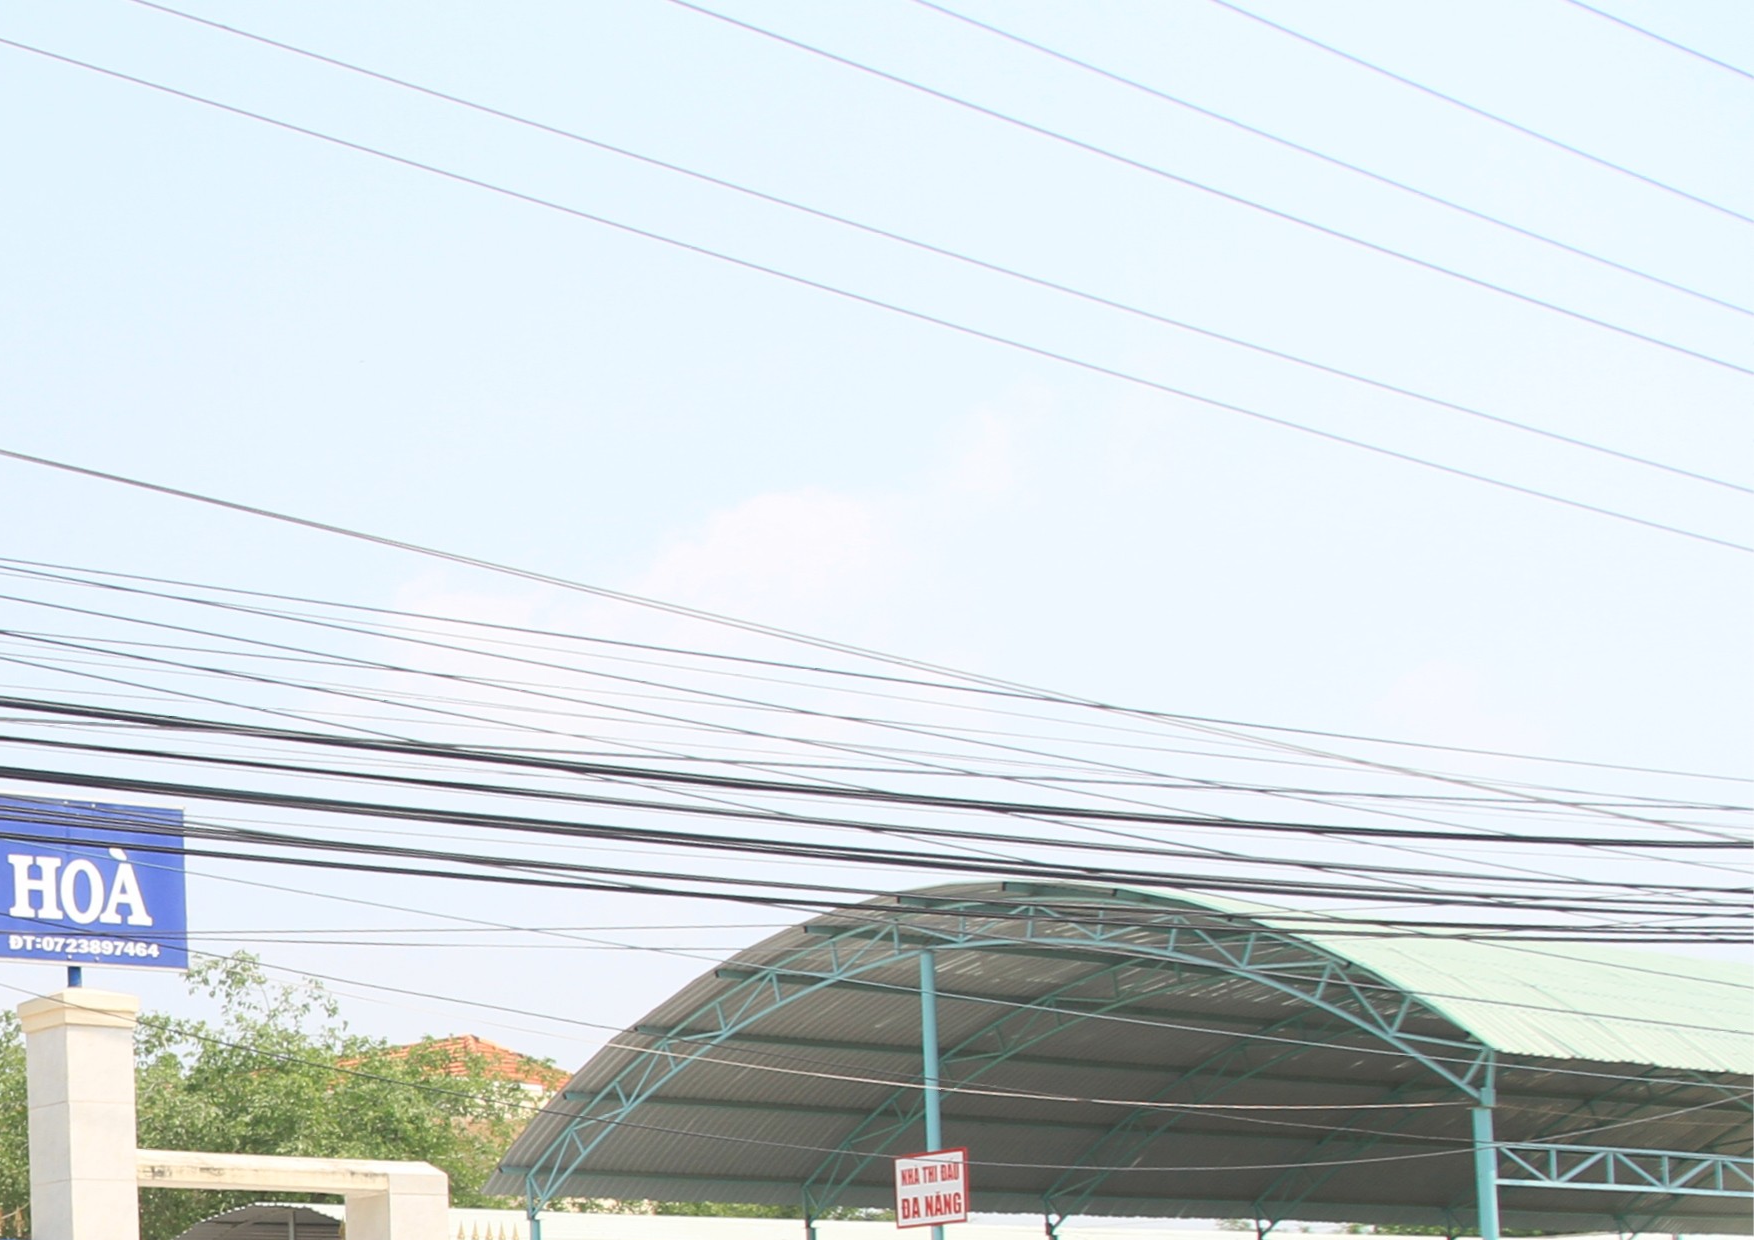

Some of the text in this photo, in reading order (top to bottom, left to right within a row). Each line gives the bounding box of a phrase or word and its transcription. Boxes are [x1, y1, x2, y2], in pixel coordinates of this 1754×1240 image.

[8, 848, 153, 927] HOÀ
[923, 1165, 938, 1183] THI
[902, 1191, 962, 1219] ĐA NĂNG
